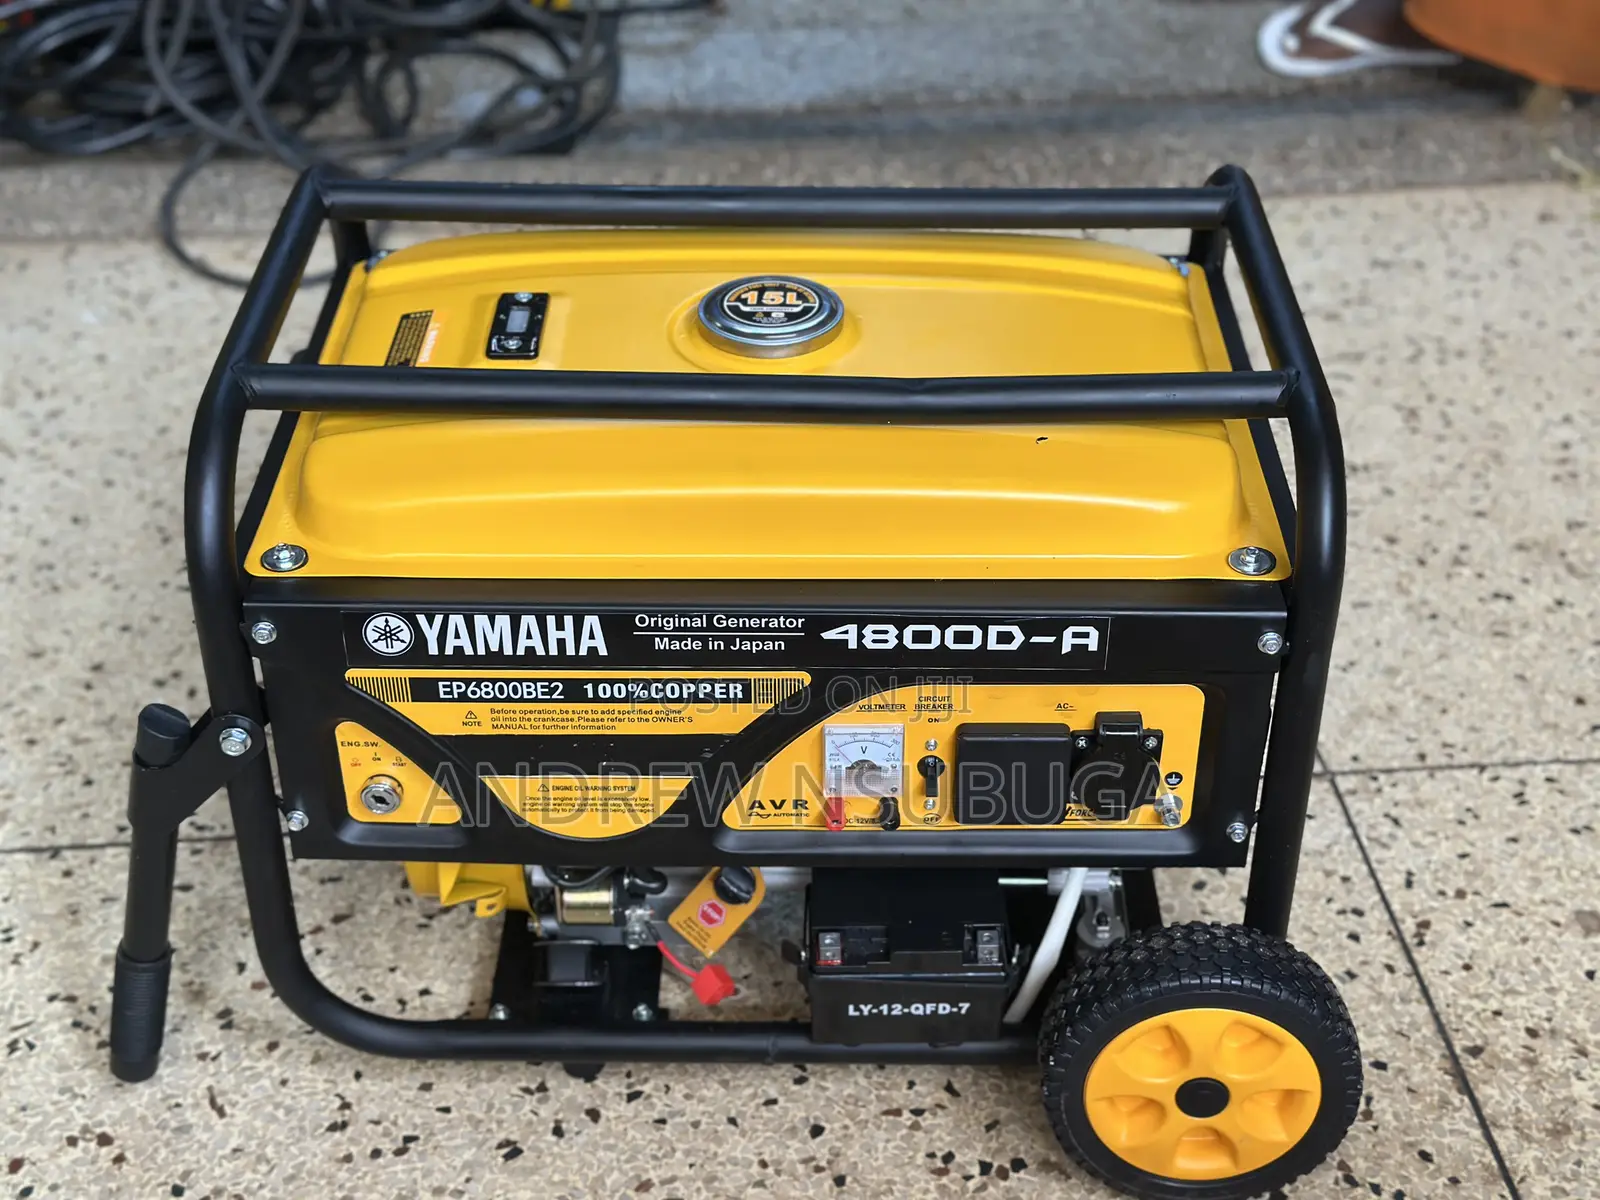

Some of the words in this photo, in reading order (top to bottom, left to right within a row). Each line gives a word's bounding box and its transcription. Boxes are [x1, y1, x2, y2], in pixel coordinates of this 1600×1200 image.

[740, 290, 802, 305] 15L
[635, 614, 706, 630] Original
[713, 615, 805, 629] Generator
[416, 614, 608, 656] YAMAHA
[820, 624, 1099, 654] 4800D-A
[654, 637, 702, 650] Made
[709, 637, 724, 650] in
[730, 638, 785, 653] Japan
[438, 681, 565, 699] EP6800BE2
[583, 682, 743, 699] 100%COPPER
[617, 708, 653, 717] specified
[654, 709, 682, 717] engine
[860, 745, 868, 754] V
[748, 799, 809, 810] AVR
[848, 1002, 971, 1016] LY-12-QFD-7
